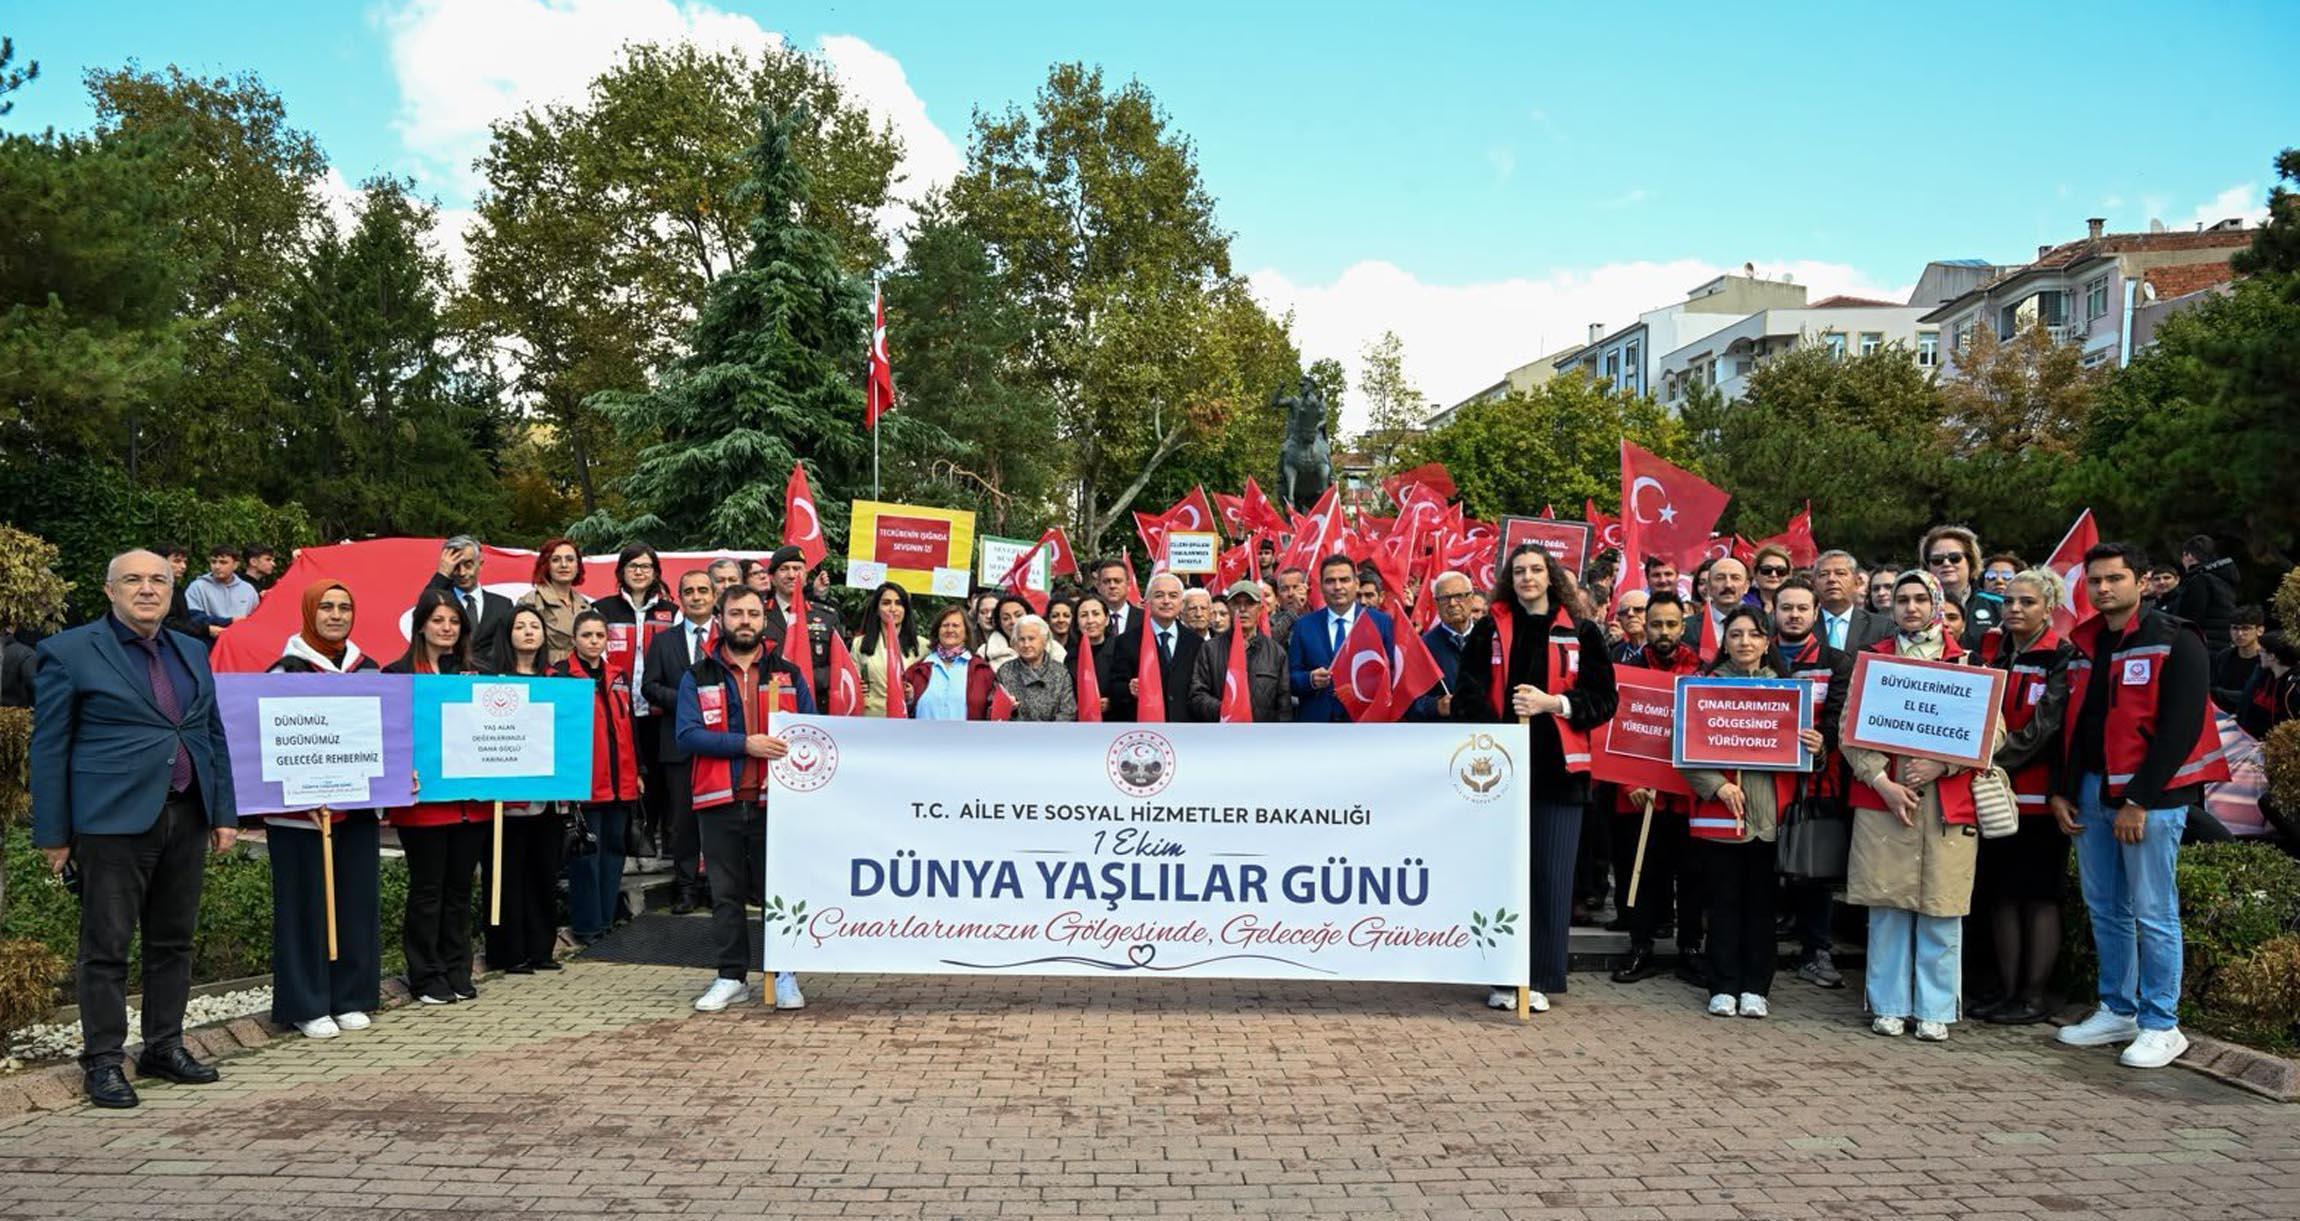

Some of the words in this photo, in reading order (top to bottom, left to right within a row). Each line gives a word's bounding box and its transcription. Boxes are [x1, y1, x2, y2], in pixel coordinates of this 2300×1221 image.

[1881, 674, 1973, 698] BÜYÜKLERİMİZLE
[1631, 702, 1643, 713] BİR
[1644, 703, 1669, 717] ÖMRÜ
[1697, 699, 1790, 712] ÇINARLARIMIZIN
[1904, 700, 1916, 711] EL
[1919, 702, 1939, 716] ELE,
[274, 715, 329, 727] DÜNÜMÜZ,
[1622, 720, 1662, 736] YÜREKLERE
[1708, 717, 1778, 730] GÖLGESİNDE
[1868, 715, 1914, 732] DÜNDEN
[1917, 723, 1970, 741] GELECEĞE
[275, 734, 340, 746] BUGÜNÜMÜZ
[1708, 733, 1778, 748] YÜRÜYORUZ
[276, 753, 323, 766] GELECEĞE
[325, 752, 379, 764] REHBERİMİZ
[911, 803, 949, 819] T.C.
[959, 798, 1005, 819] AİLE
[1012, 804, 1038, 820] VE
[1045, 804, 1124, 822] SOSYAL
[1131, 801, 1249, 823] HİZMETLER
[1256, 805, 1371, 825] BAKANLIĞI
[1094, 830, 1107, 855] 1
[1112, 827, 1186, 858] Ekim
[851, 849, 1024, 898] DÜNYA
[1036, 861, 1268, 911] YAŞLILAR
[1281, 856, 1429, 906] GÜNÜ
[808, 906, 1042, 948] Çınarlarımızın
[1045, 911, 1214, 949] Gölgesinde,
[1220, 914, 1345, 953] Geleceğe
[1347, 916, 1471, 950] Güvenle
